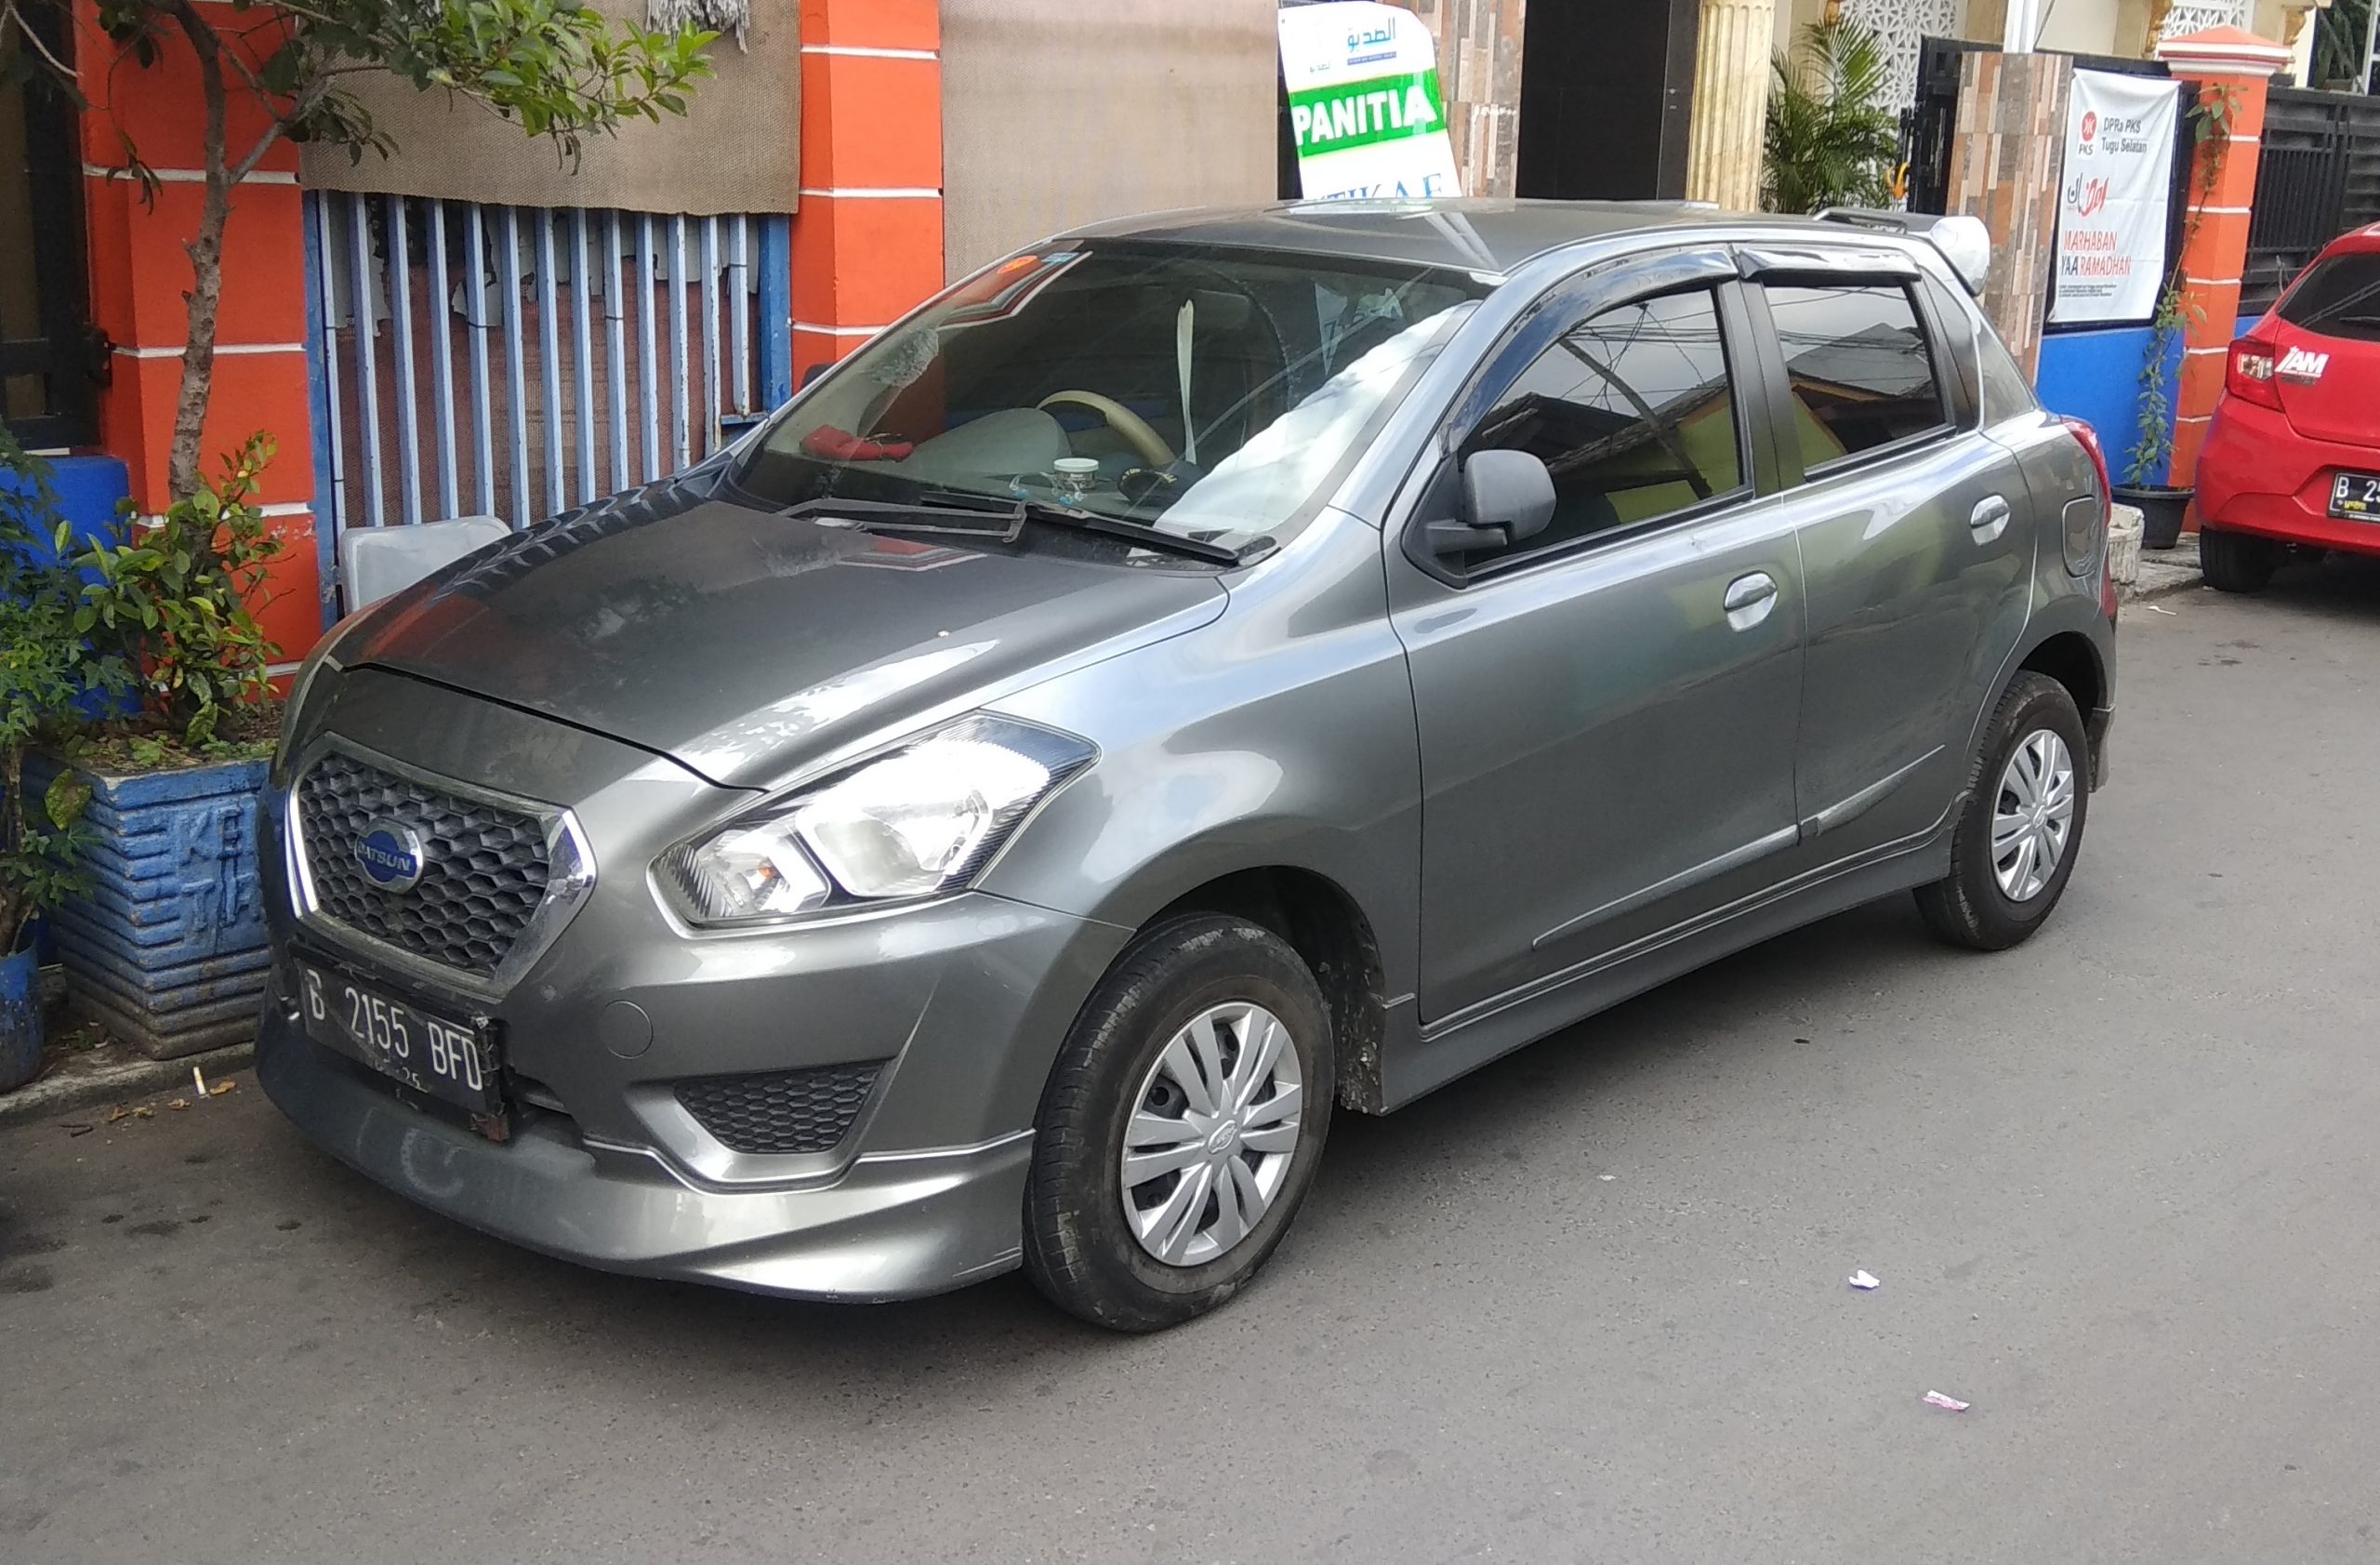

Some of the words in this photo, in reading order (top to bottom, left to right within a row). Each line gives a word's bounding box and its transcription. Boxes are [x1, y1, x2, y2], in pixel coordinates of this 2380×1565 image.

[1292, 85, 1438, 147] PANITIA
[2104, 117, 2123, 132] DPRa
[2125, 119, 2141, 134] PKS
[2079, 143, 2094, 155] PKS
[2102, 137, 2119, 154] Tugu
[2121, 138, 2147, 153] Selatan
[2064, 230, 2117, 251] MARHABAN
[2061, 255, 2078, 275] YAA
[2080, 255, 2132, 276] RAMADHAN
[2335, 476, 2349, 497] B
[345, 987, 410, 1058] 2155
[428, 1022, 483, 1092] BFD
